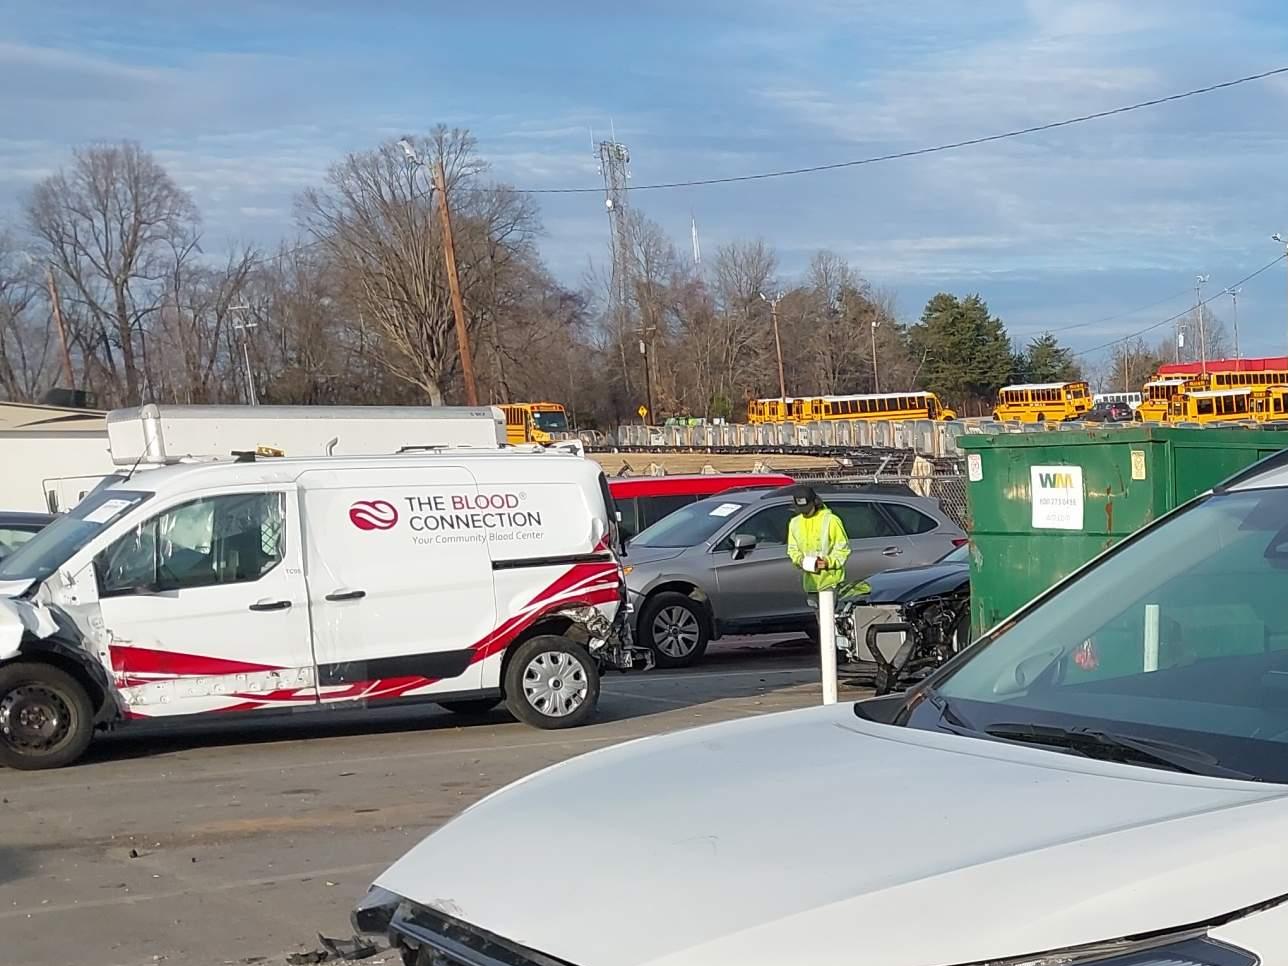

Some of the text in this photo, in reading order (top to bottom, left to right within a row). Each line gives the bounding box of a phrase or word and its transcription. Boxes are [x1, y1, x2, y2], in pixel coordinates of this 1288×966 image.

[1039, 473, 1074, 489] WM
[404, 494, 519, 512] THE BLOOD
[409, 512, 542, 531] CONNECTION
[412, 531, 544, 545] Your Community Blood Center
